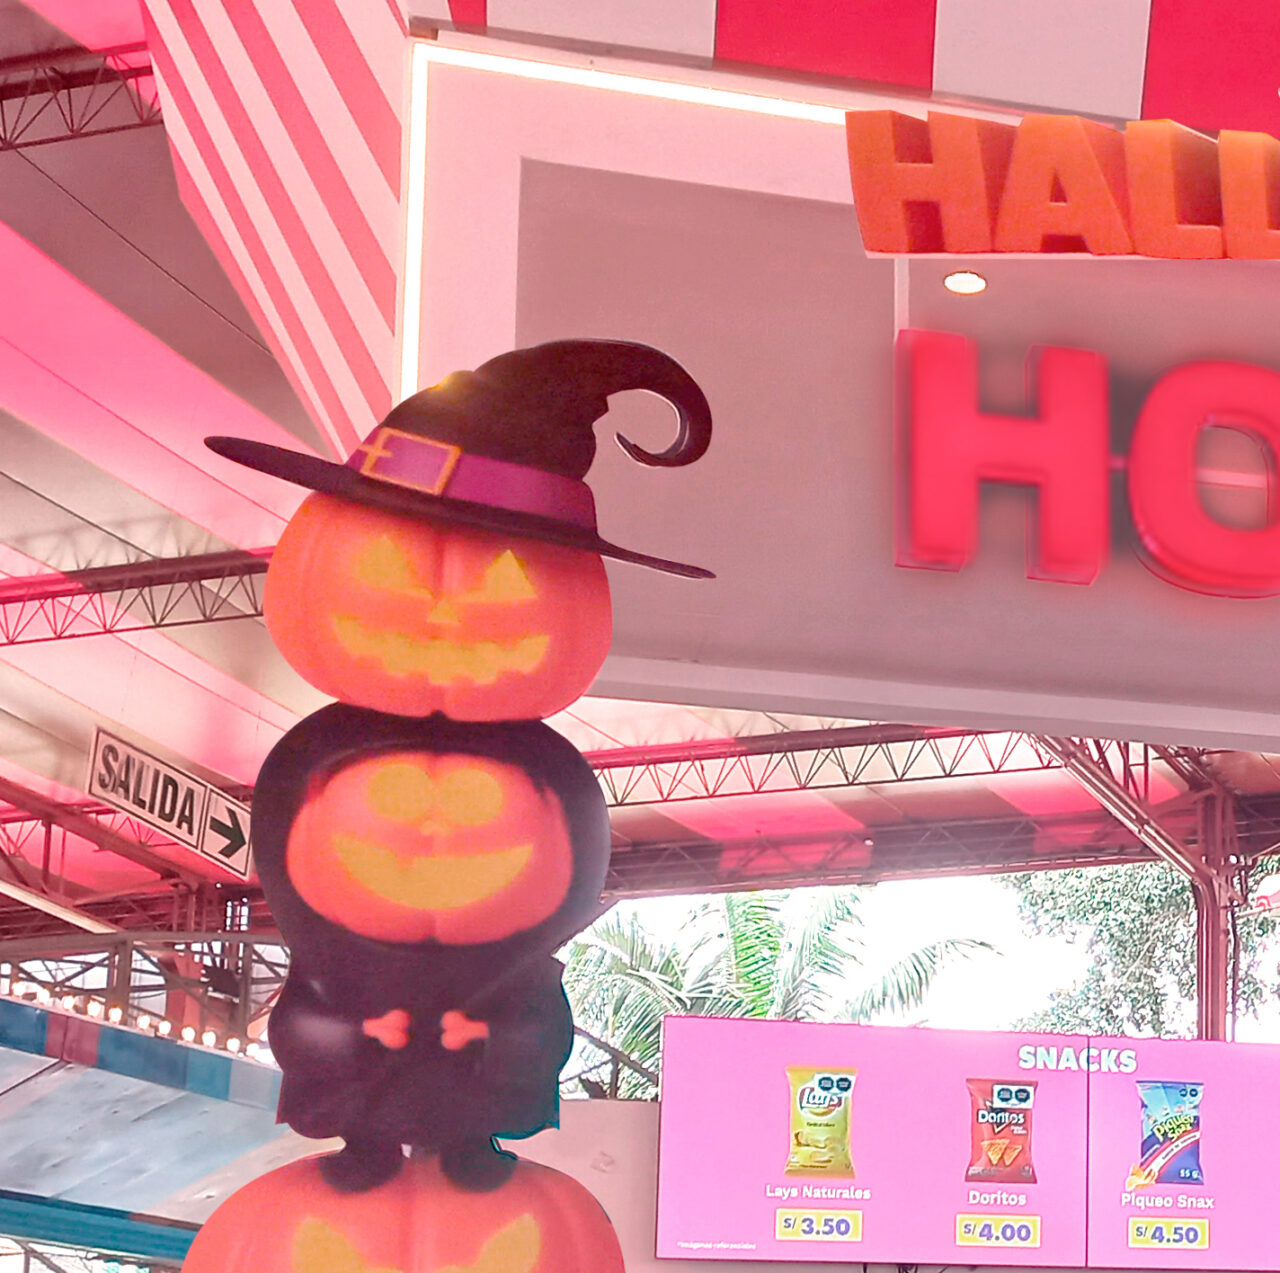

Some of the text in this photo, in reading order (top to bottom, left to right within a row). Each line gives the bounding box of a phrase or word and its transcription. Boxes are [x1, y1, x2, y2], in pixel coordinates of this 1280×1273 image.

[98, 743, 196, 837] SALIDA
[1017, 1044, 1138, 1074] SNACKS
[977, 1109, 1025, 1125] Doritos
[765, 1184, 871, 1201] Lays Naturales
[968, 1190, 1027, 1205] Doritos
[1121, 1193, 1215, 1210] Piqueo Snax
[801, 1216, 851, 1236] 3.50
[978, 1222, 1032, 1242] 4.00
[1150, 1225, 1200, 1244] 4.50
